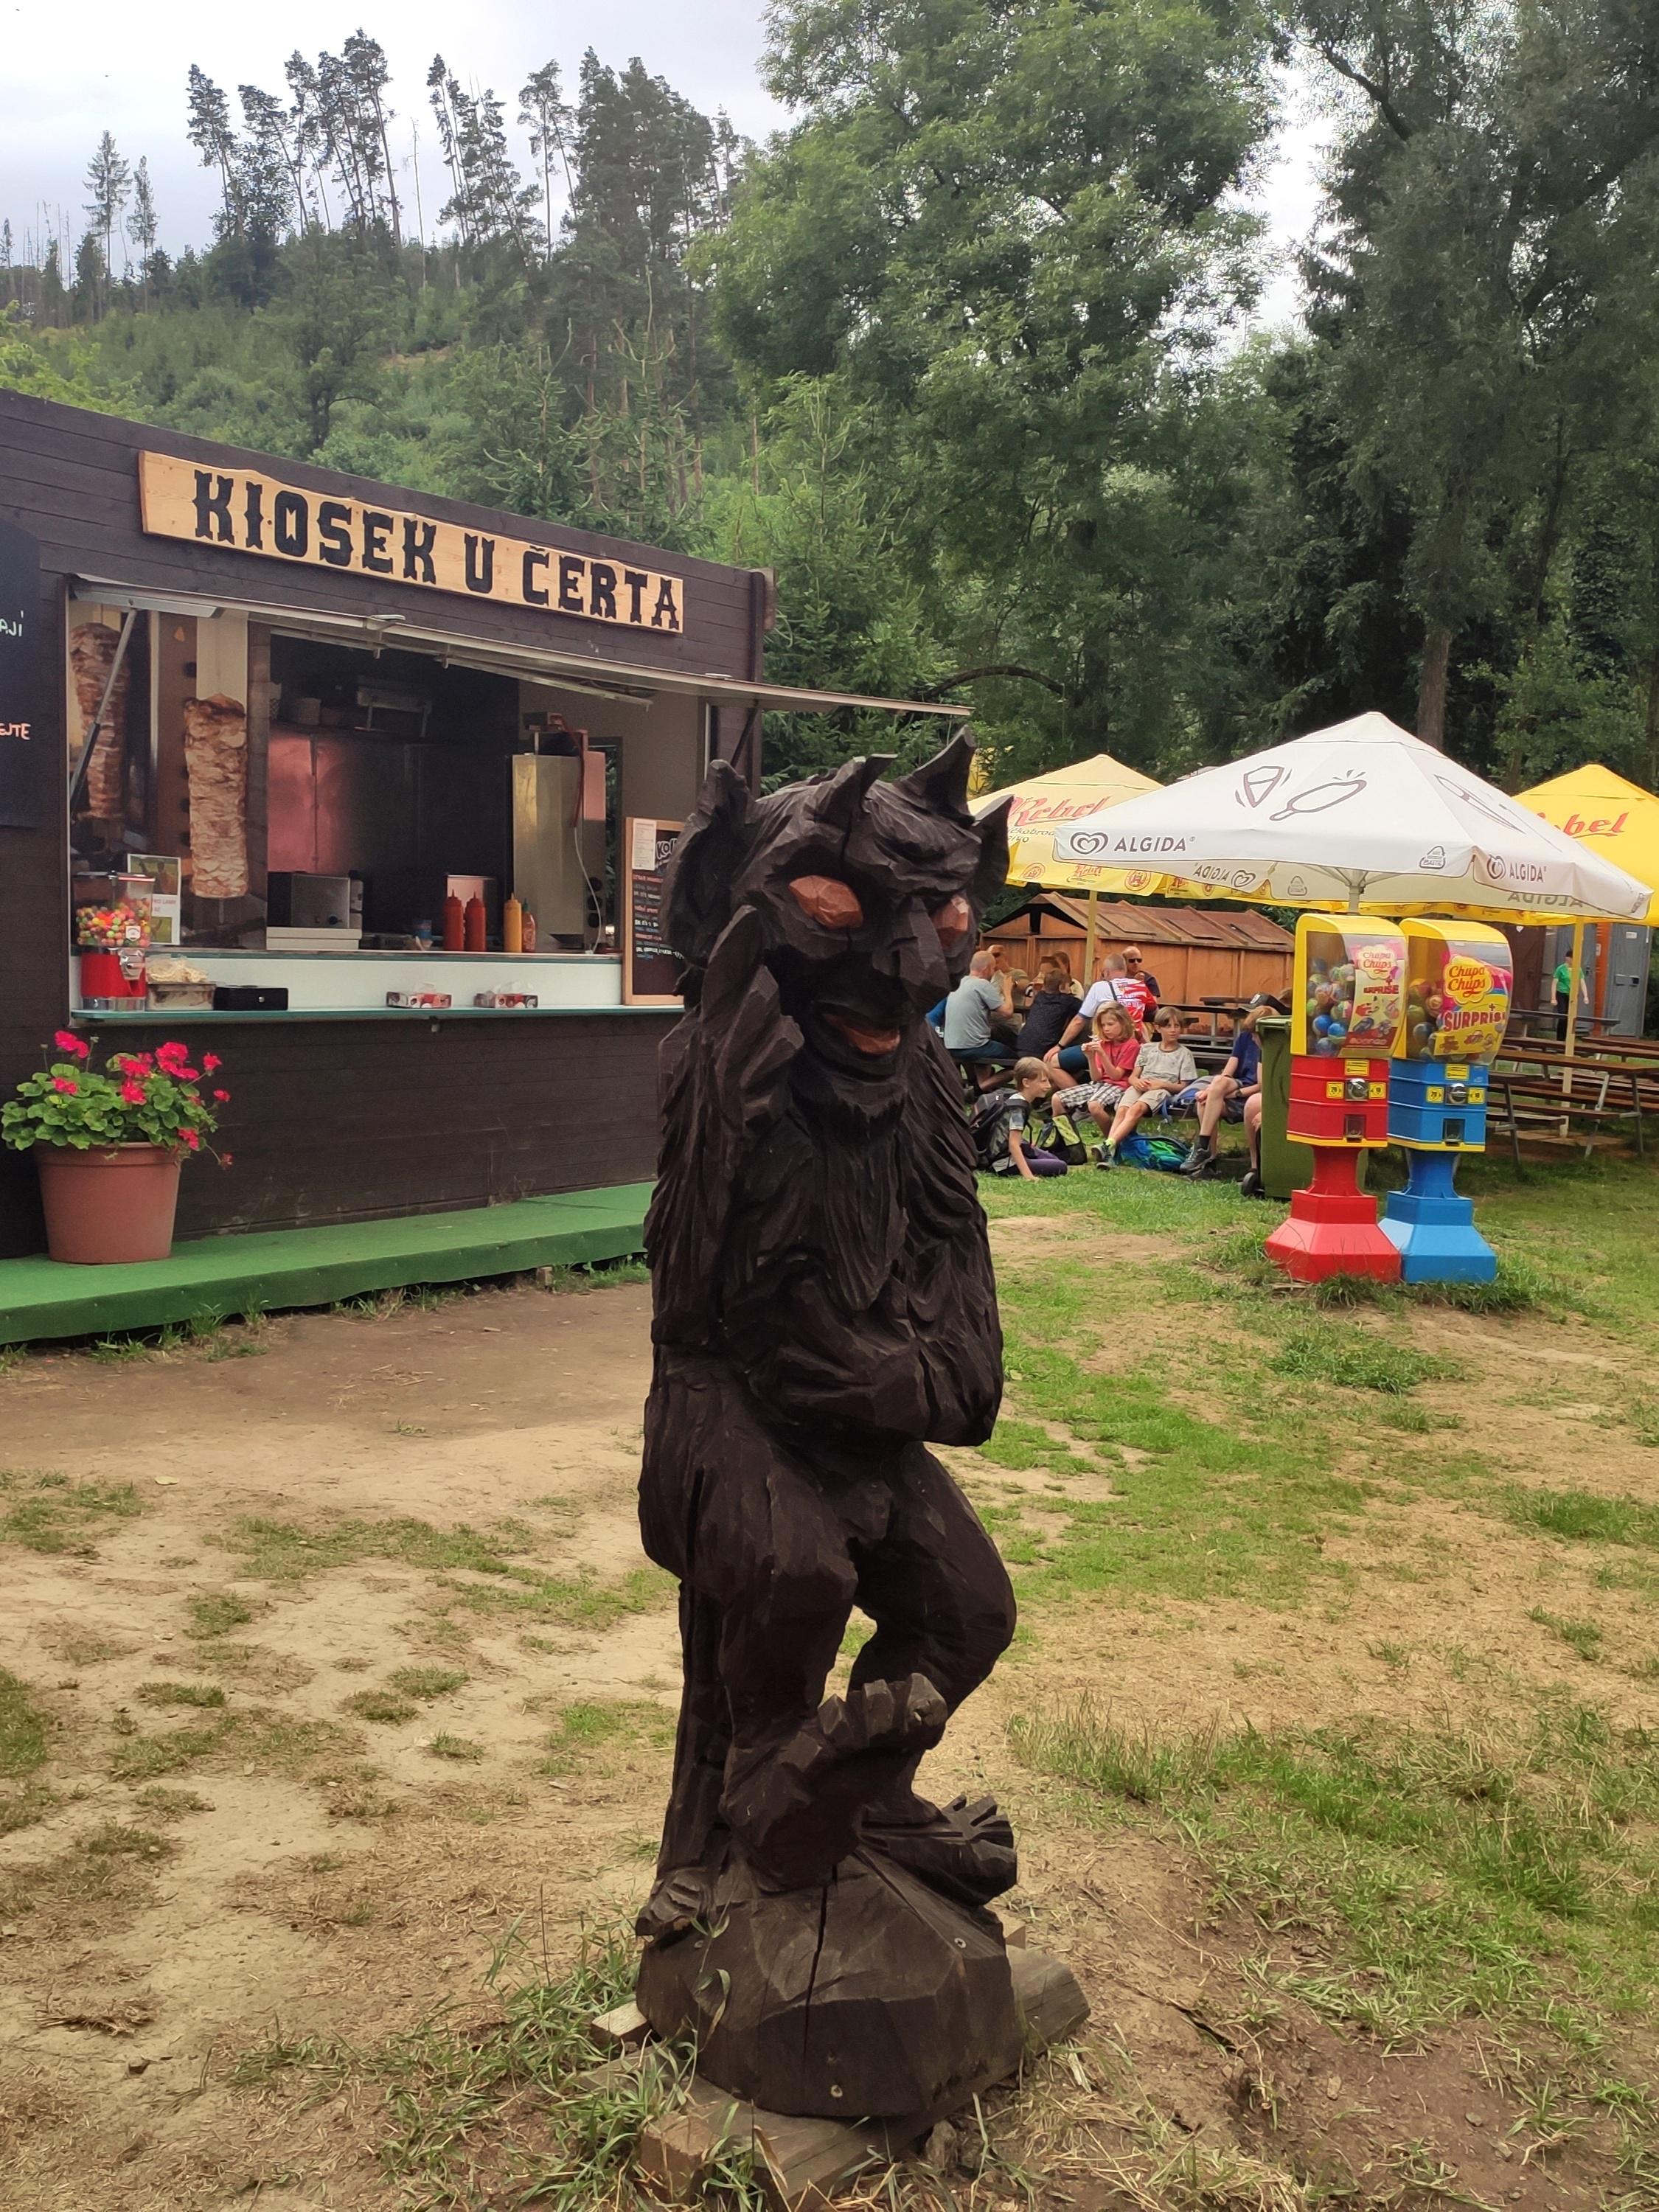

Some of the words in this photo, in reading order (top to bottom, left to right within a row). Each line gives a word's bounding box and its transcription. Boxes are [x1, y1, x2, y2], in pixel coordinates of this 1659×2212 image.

[192, 468, 437, 585] KIOSEK
[464, 532, 495, 594] U
[522, 544, 680, 630] ČERTA
[1537, 812, 1629, 837] bel
[1113, 836, 1186, 852] ALGIDA
[1509, 863, 1545, 883] ALGIDA
[1449, 965, 1485, 980] Chupa
[1447, 978, 1486, 998] Chups
